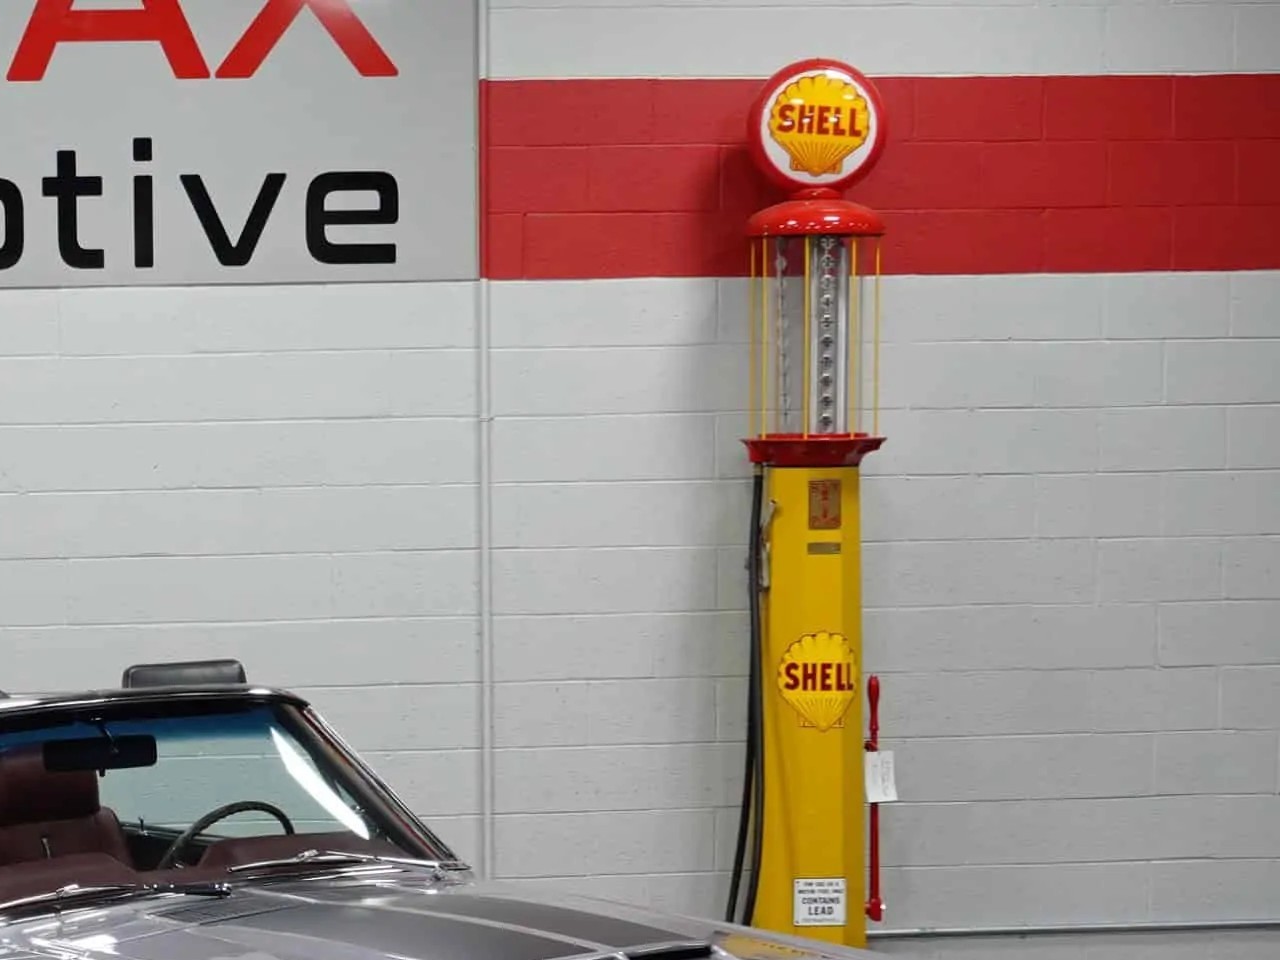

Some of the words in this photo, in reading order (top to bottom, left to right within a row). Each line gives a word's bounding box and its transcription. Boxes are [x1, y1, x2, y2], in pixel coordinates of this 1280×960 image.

[777, 104, 862, 137] SHELL
[784, 662, 854, 691] SHELL
[808, 906, 834, 915] LEAD
